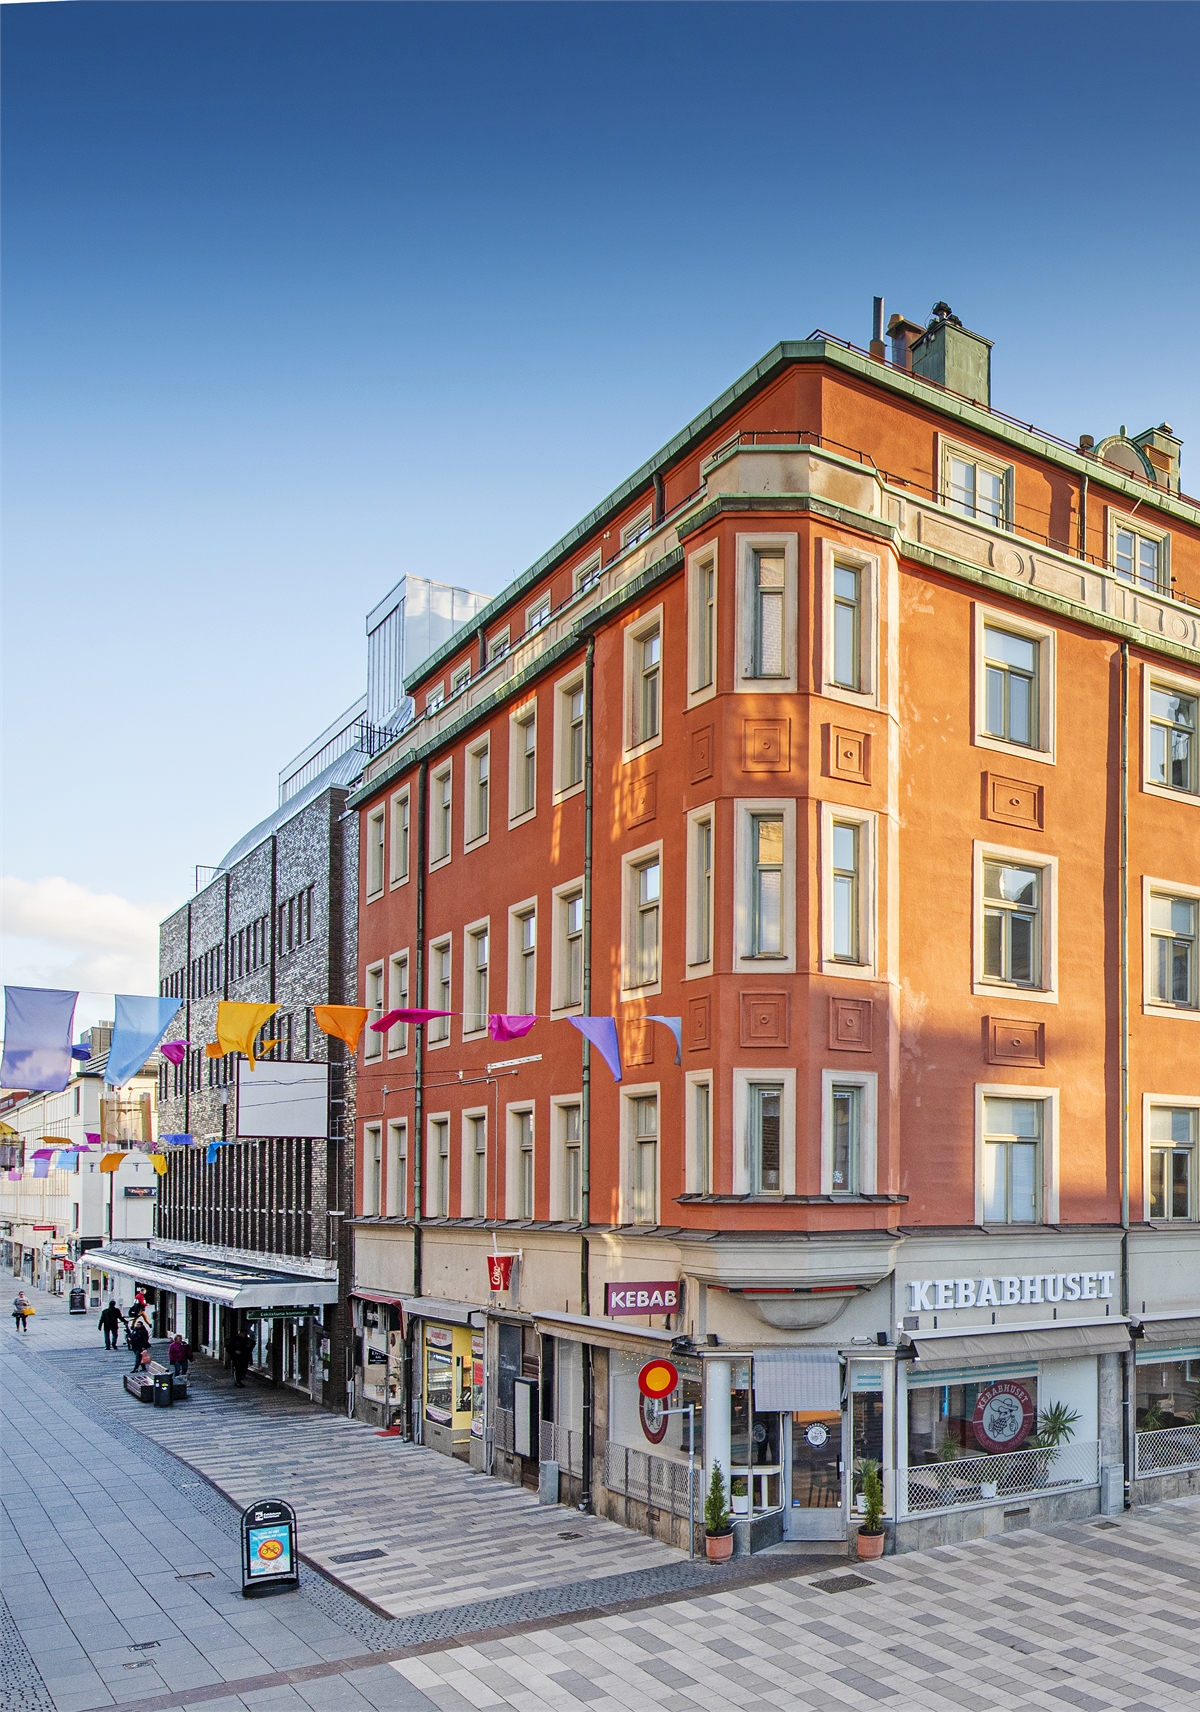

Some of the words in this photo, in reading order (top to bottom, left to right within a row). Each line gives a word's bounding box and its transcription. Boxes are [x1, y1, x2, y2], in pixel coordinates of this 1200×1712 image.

[612, 1290, 678, 1309] KEBAB
[909, 1271, 1117, 1312] KEBABHUSET
[977, 1384, 1030, 1411] KEBABHUSET
